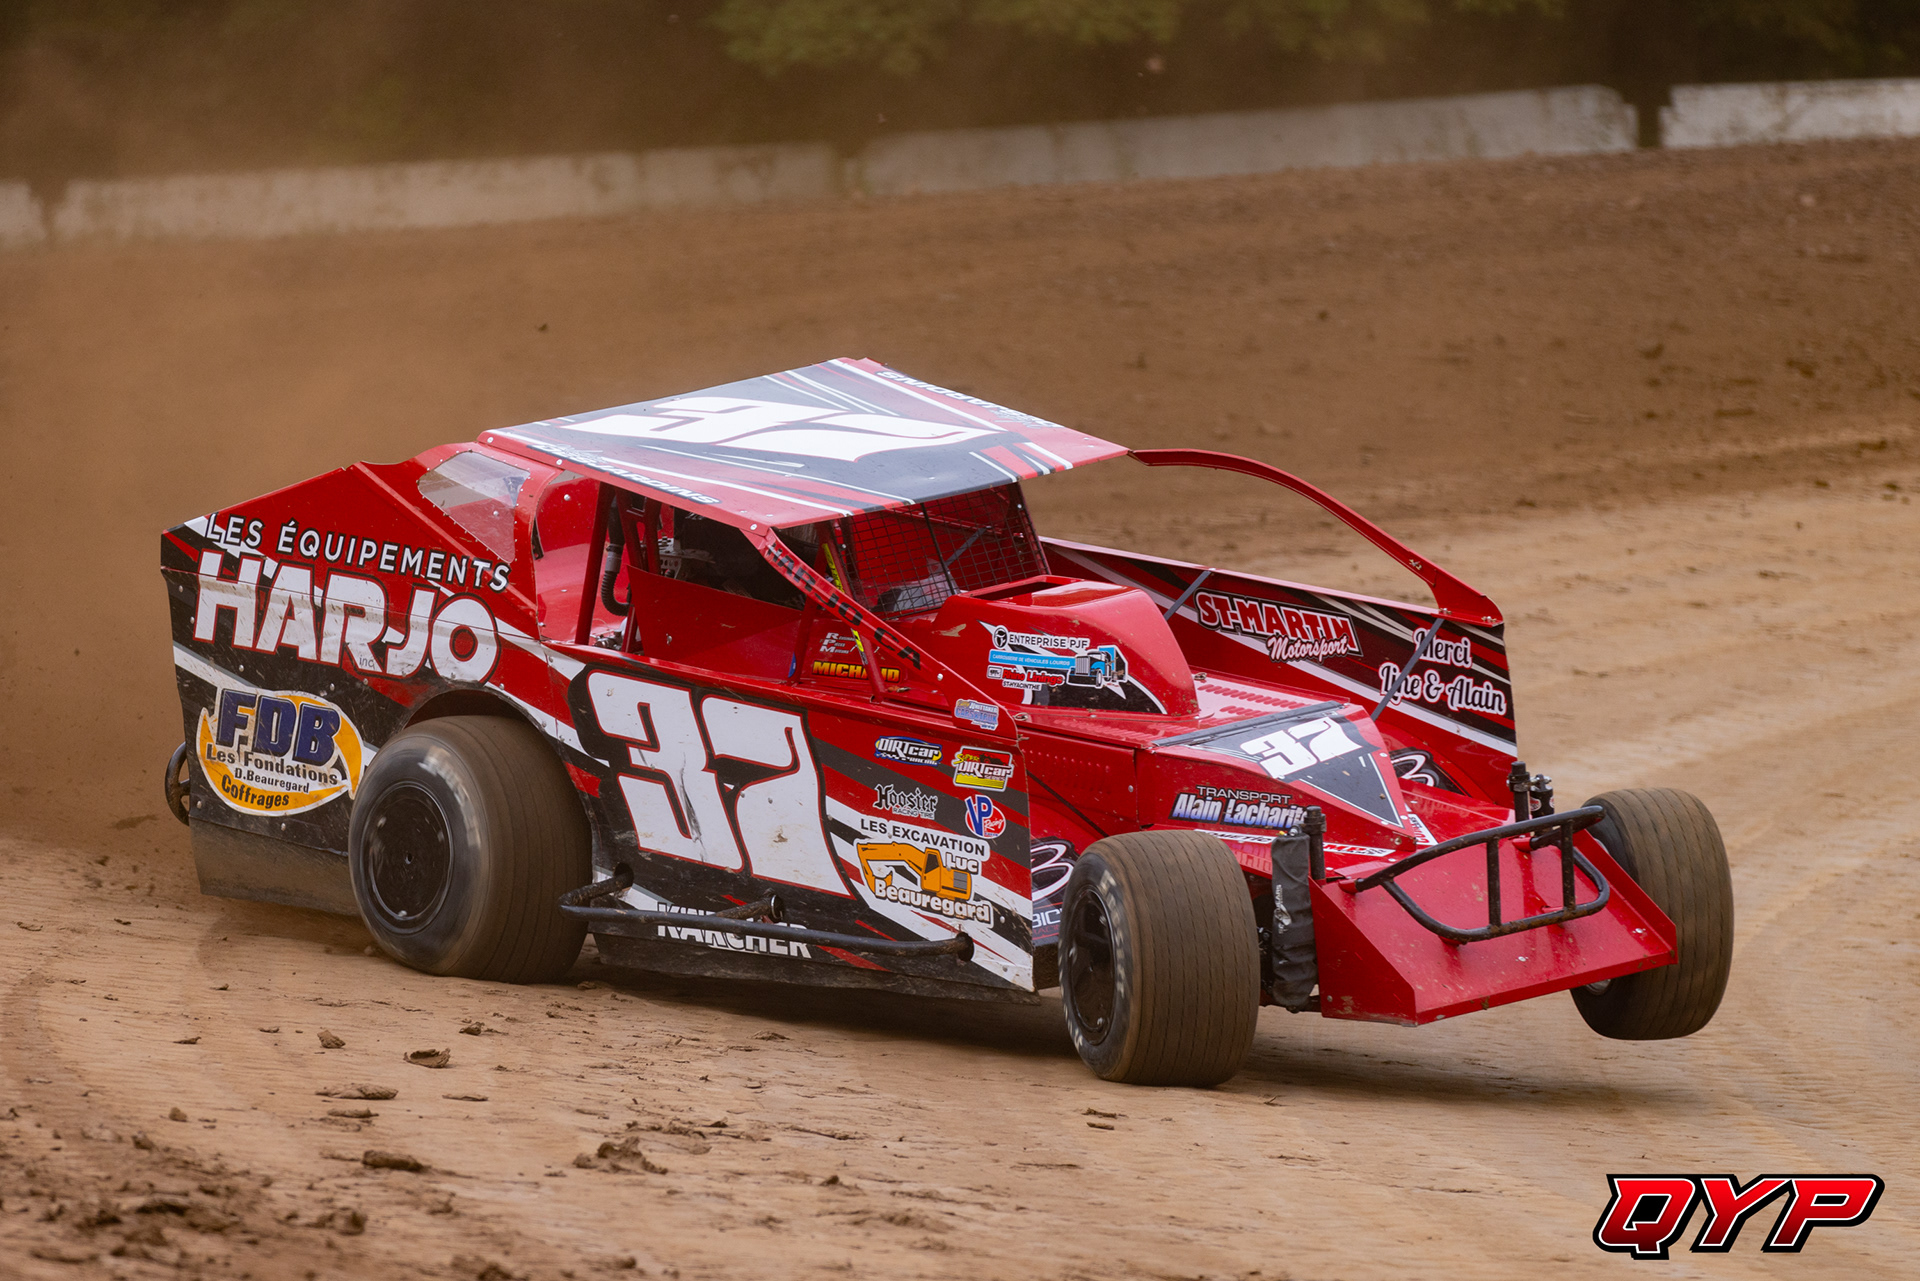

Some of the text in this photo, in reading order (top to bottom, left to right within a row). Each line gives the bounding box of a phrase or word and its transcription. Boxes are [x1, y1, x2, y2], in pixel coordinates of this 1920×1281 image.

[560, 397, 1006, 461] 37
[206, 513, 512, 592] LES ÉQUIPEMENTS
[193, 551, 500, 687] HARJO
[1196, 591, 1359, 651] ST-MARTIN
[1009, 634, 1088, 649] ENTREPRISE PJF
[1267, 633, 1348, 662] Motorsport
[1414, 630, 1470, 665] Merci
[1002, 668, 1063, 686] Rhino Linings
[1423, 671, 1444, 701] &
[1447, 678, 1504, 713] Alain
[216, 688, 343, 767] FDB
[206, 743, 338, 786] Les Fondations
[877, 737, 941, 760] DIRTcar
[1240, 716, 1363, 779] 37
[234, 767, 310, 794] D.Beauregard
[587, 670, 857, 900] 37
[956, 758, 1013, 779] DIRTcar
[222, 774, 290, 810] Coffrages
[872, 783, 938, 812] Hoosier
[1170, 793, 1223, 822] Alain
[1196, 785, 1292, 805] TRANSPORT
[891, 804, 936, 818] RACING TIRE
[965, 793, 994, 836] VP
[861, 818, 985, 857] LES EXCAVATION
[874, 878, 992, 923] Beauregard
